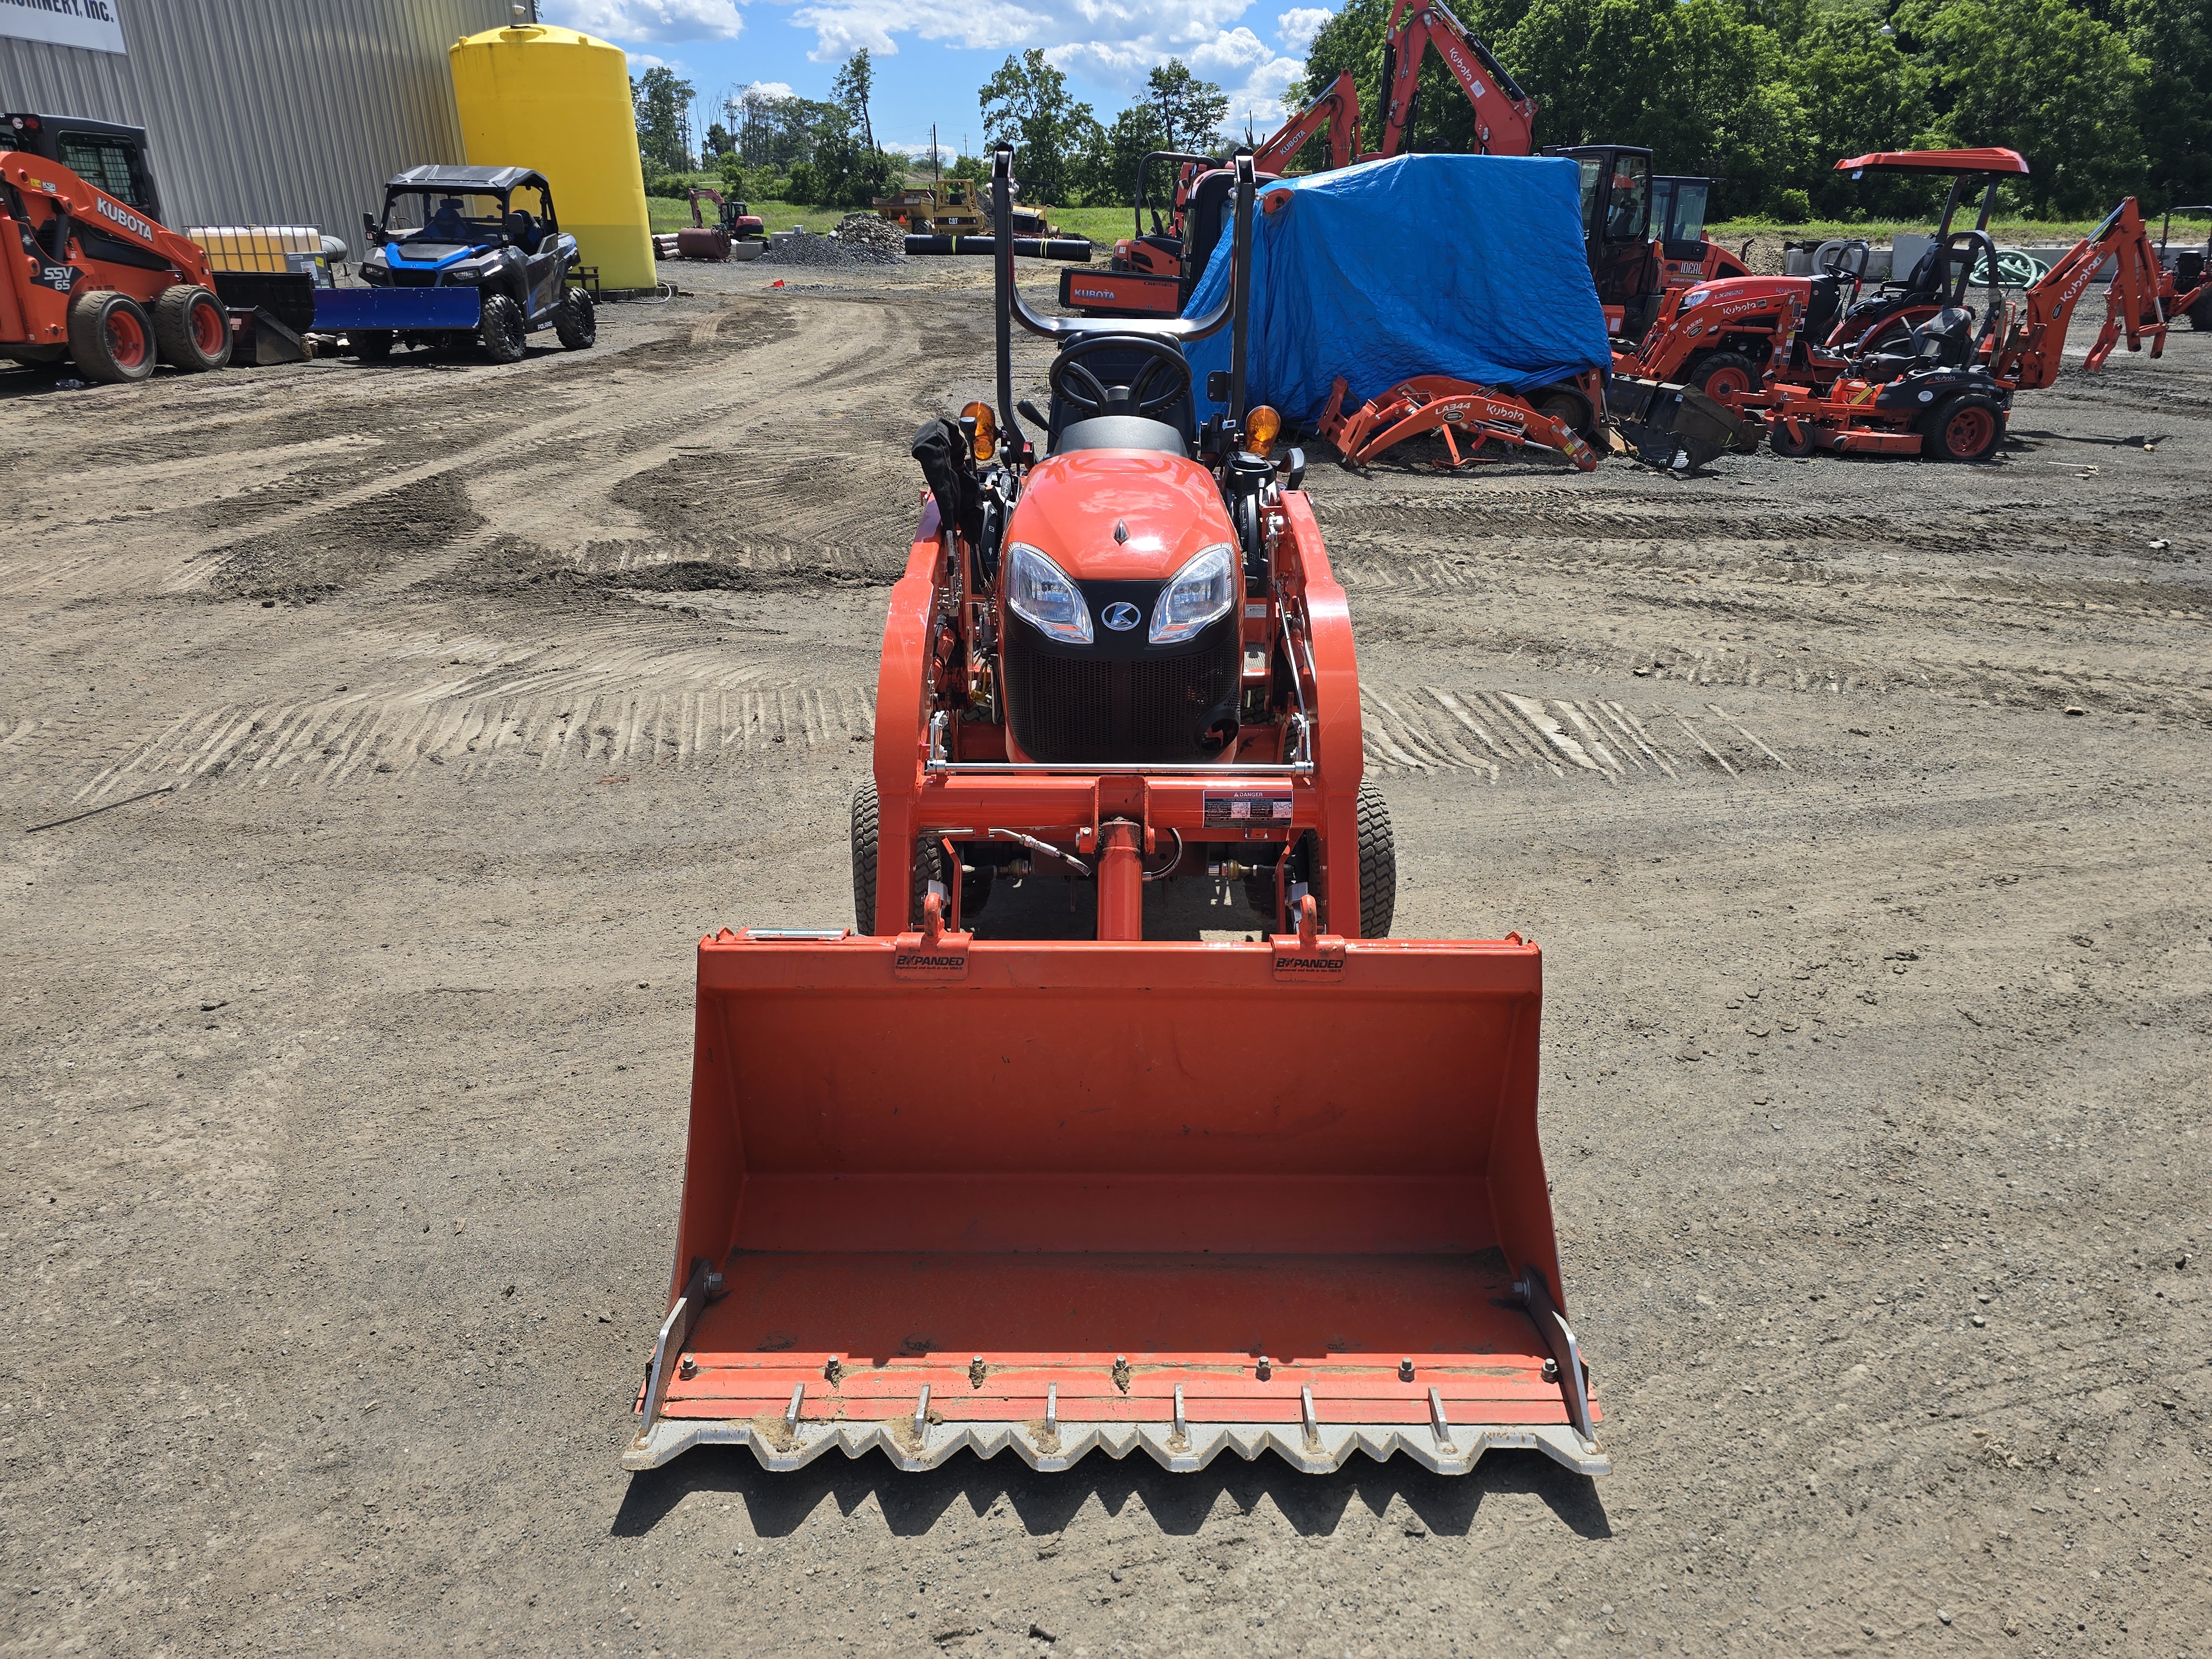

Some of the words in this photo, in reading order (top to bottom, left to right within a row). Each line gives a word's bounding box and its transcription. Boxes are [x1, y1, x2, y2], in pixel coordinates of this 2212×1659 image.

[1449, 48, 1472, 81] Kubota
[1280, 130, 1306, 155] KUBOTA
[97, 196, 153, 242] KUBOTA
[44, 267, 73, 280] SSV
[1681, 262, 1702, 274] IDEAL
[55, 280, 70, 290] 65
[2060, 262, 2096, 302] Kubota
[1074, 288, 1115, 300] KUBOTA
[1714, 289, 1744, 299] LX2620
[1723, 301, 1756, 315] Kubota
[538, 320, 552, 330] POLARIS
[1435, 402, 1471, 415] LA344
[1486, 403, 1525, 421] Kubota
[896, 955, 965, 966] BXPANDED
[1276, 958, 1344, 968] BXPANDED
